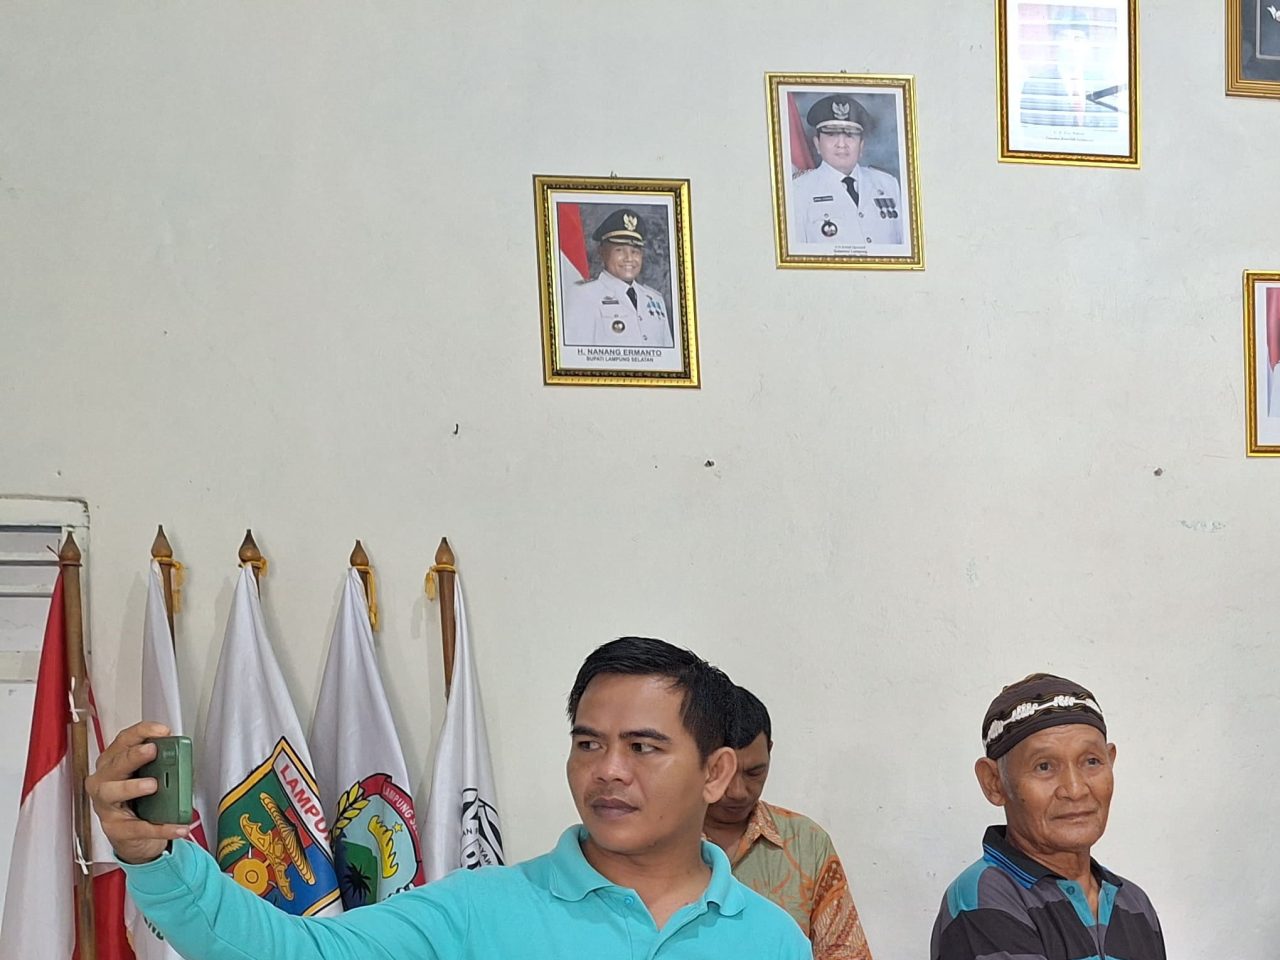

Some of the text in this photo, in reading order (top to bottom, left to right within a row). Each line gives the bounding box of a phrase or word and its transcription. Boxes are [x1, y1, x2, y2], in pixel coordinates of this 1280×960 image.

[577, 348, 662, 357] H. NANANG ERMANTO
[280, 764, 331, 841] LAMPU
[383, 784, 414, 818] LAMPUNG
